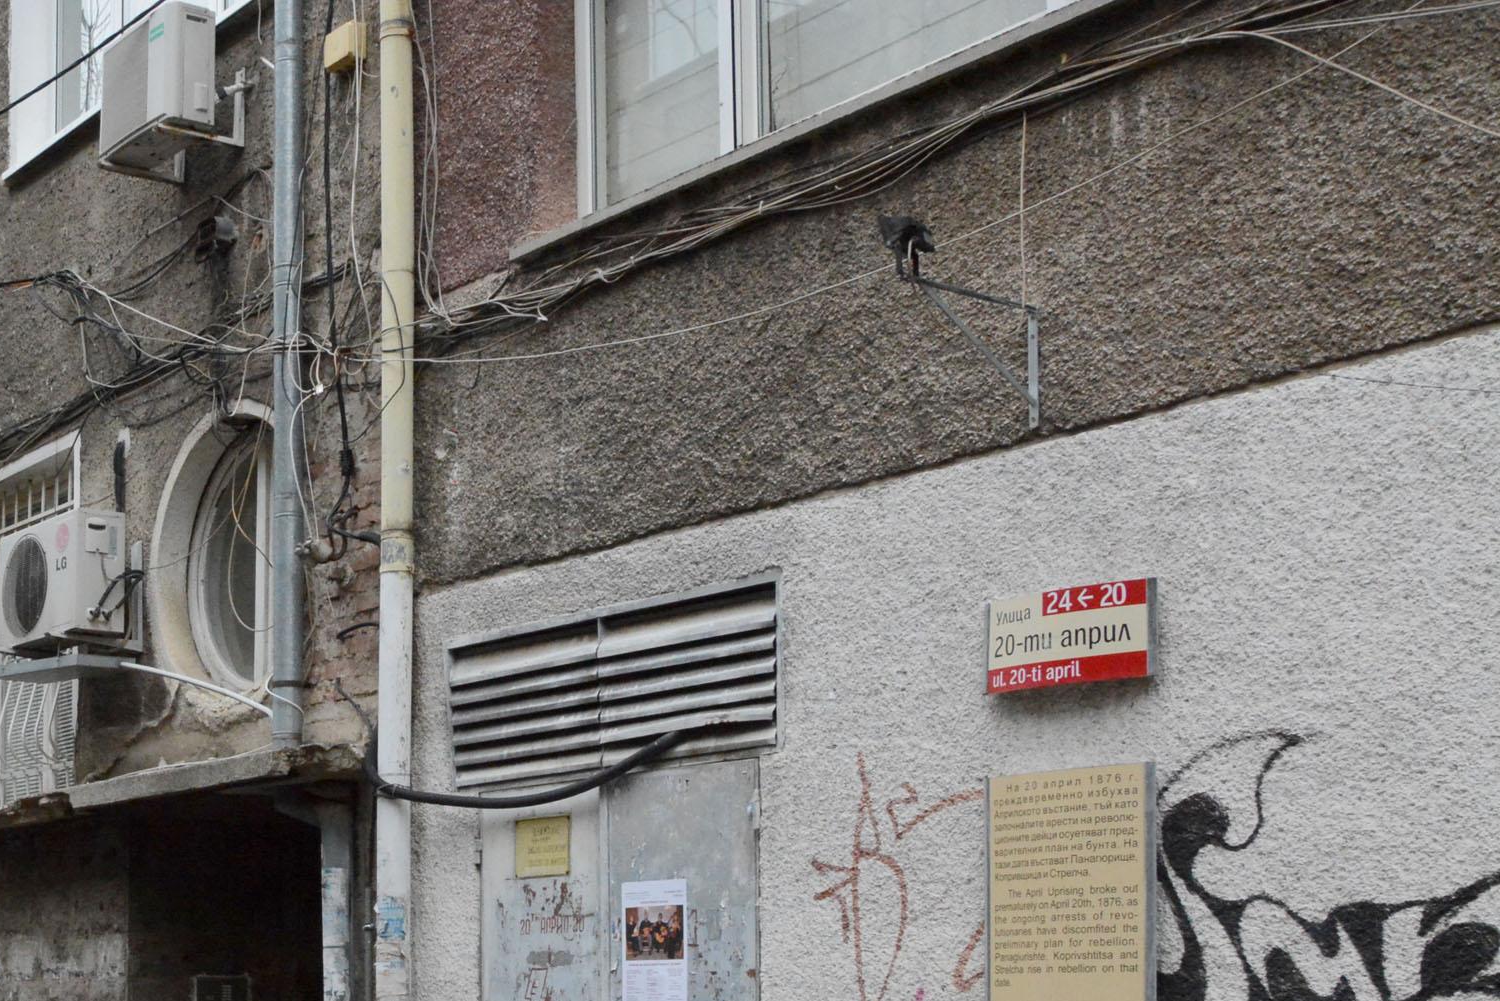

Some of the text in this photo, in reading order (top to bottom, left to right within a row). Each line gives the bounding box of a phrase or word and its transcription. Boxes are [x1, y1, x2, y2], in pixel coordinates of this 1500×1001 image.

[56, 556, 67, 571] LG
[1046, 582, 1127, 613] 24 20
[996, 605, 1031, 626] Улица
[994, 623, 1131, 658] 20-ти април
[1009, 664, 1042, 685] 20-ti
[1046, 660, 1081, 683] april
[1006, 784, 1019, 792] На
[1024, 781, 1037, 791] 20
[1043, 778, 1081, 789] април
[1090, 774, 1122, 784] 1876
[1088, 787, 1138, 799] избухва
[1094, 801, 1112, 811] тъй
[1115, 800, 1138, 809] като
[1046, 816, 1078, 828] арести
[1081, 815, 1092, 824] на
[1095, 813, 1138, 825] револю-
[1059, 828, 1106, 841] осуетяват
[1109, 827, 1138, 837] пред-
[1045, 844, 1068, 853] план
[1071, 842, 1083, 850] на
[1124, 839, 1138, 848] На
[1008, 883, 1138, 899] The April Uprising broke out
[1038, 901, 1049, 909] on
[1051, 899, 1070, 910] April
[1127, 898, 1138, 906] as
[995, 911, 1138, 925] the ongoing arrests of revo-
[1037, 926, 1057, 935] have
[1062, 924, 1117, 934] discomfited
[1123, 924, 1138, 933] the
[995, 937, 1138, 950] preliminary plan for rebellion.
[1053, 950, 1114, 961] Koprivshtitsa
[1120, 949, 1138, 959] and
[1028, 964, 1042, 973] rise
[1046, 965, 1054, 973] in
[1058, 963, 1097, 973] rebellion
[1102, 964, 1114, 973] on
[1120, 963, 1138, 973] that
